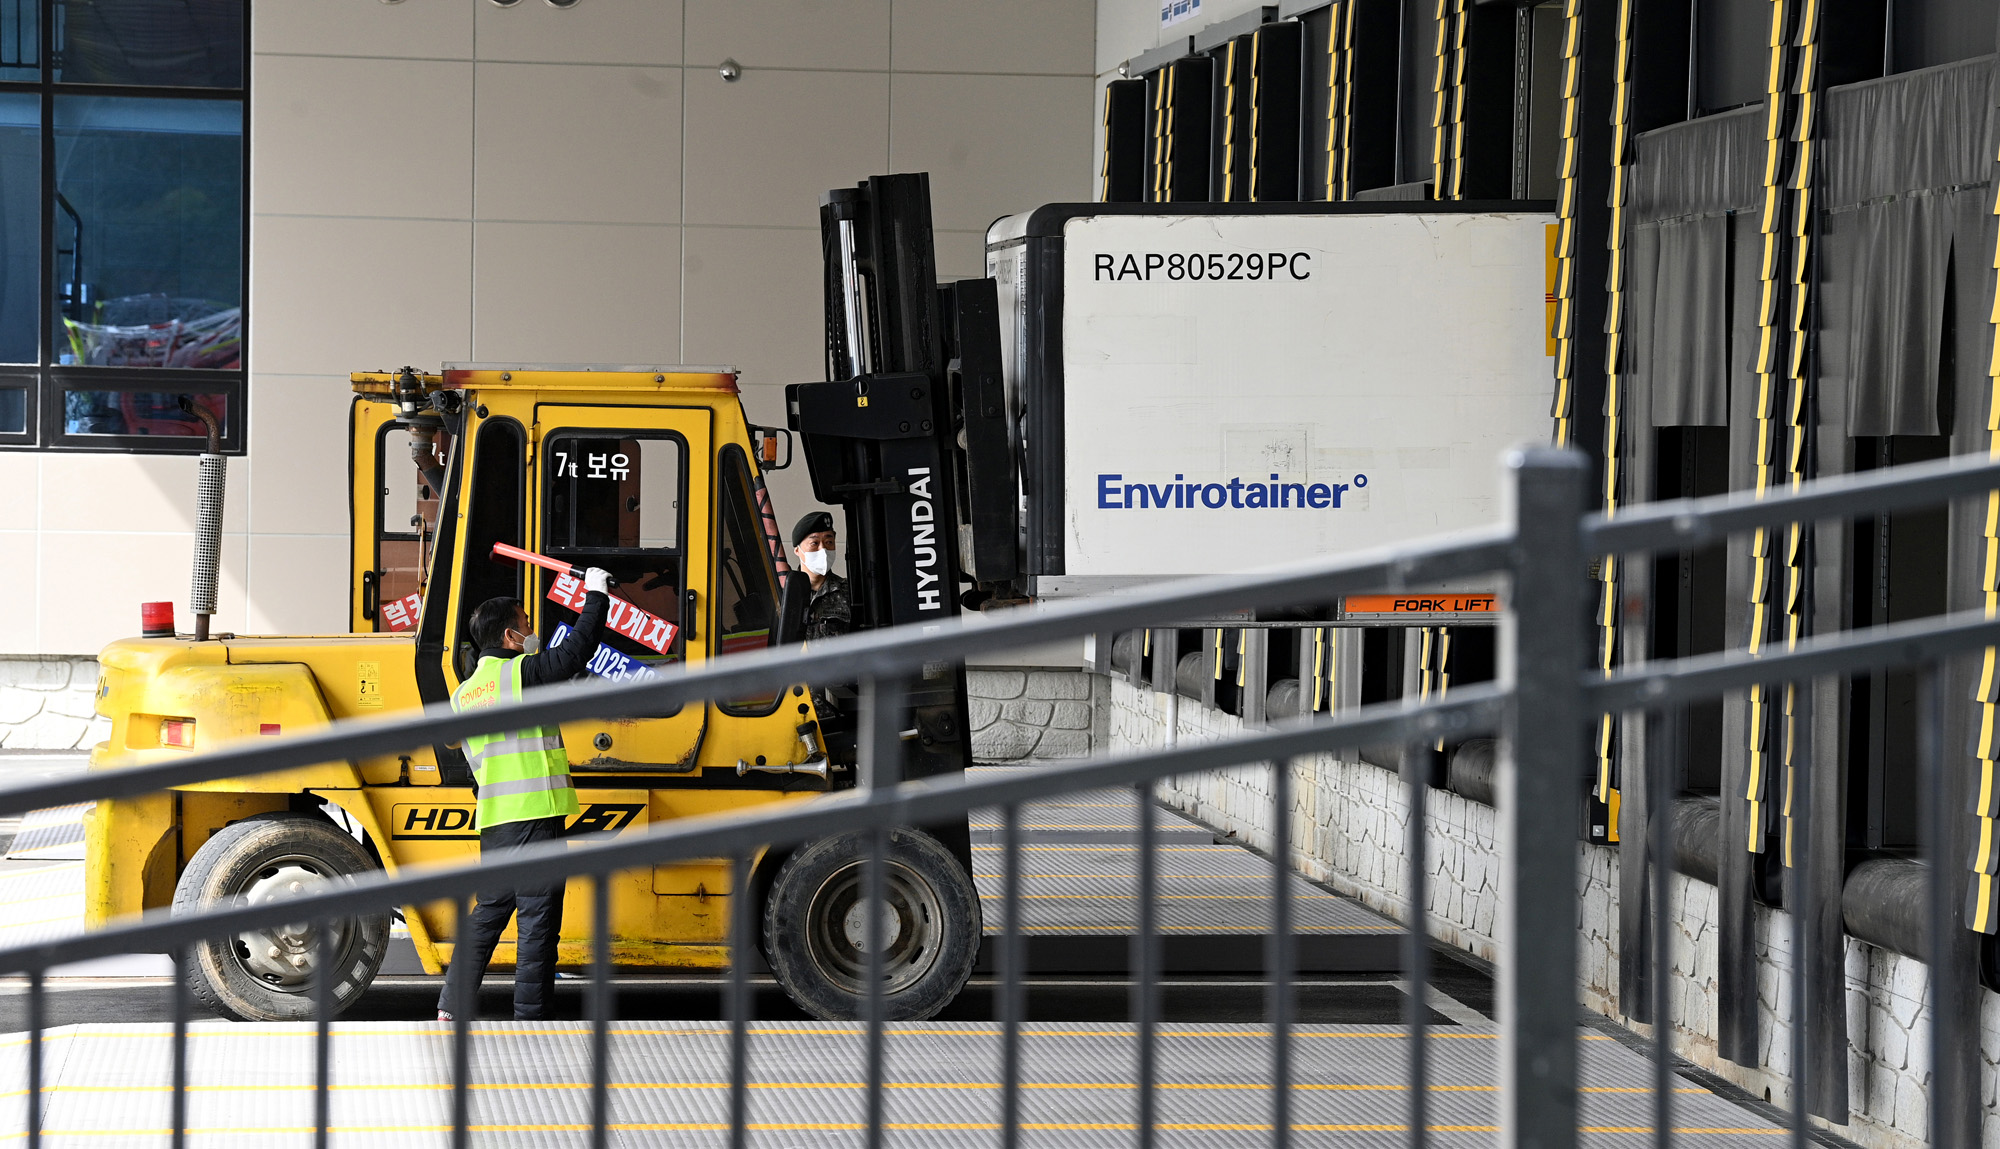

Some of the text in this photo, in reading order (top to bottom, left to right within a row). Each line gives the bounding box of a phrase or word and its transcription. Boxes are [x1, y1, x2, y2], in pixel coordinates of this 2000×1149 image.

[1095, 252, 1311, 281] RAP80529PC
[587, 452, 630, 481] 보유
[908, 467, 941, 611] HYUNDAI
[1393, 599, 1495, 611] FORK LIFT
[460, 680, 496, 707] COVID-19
